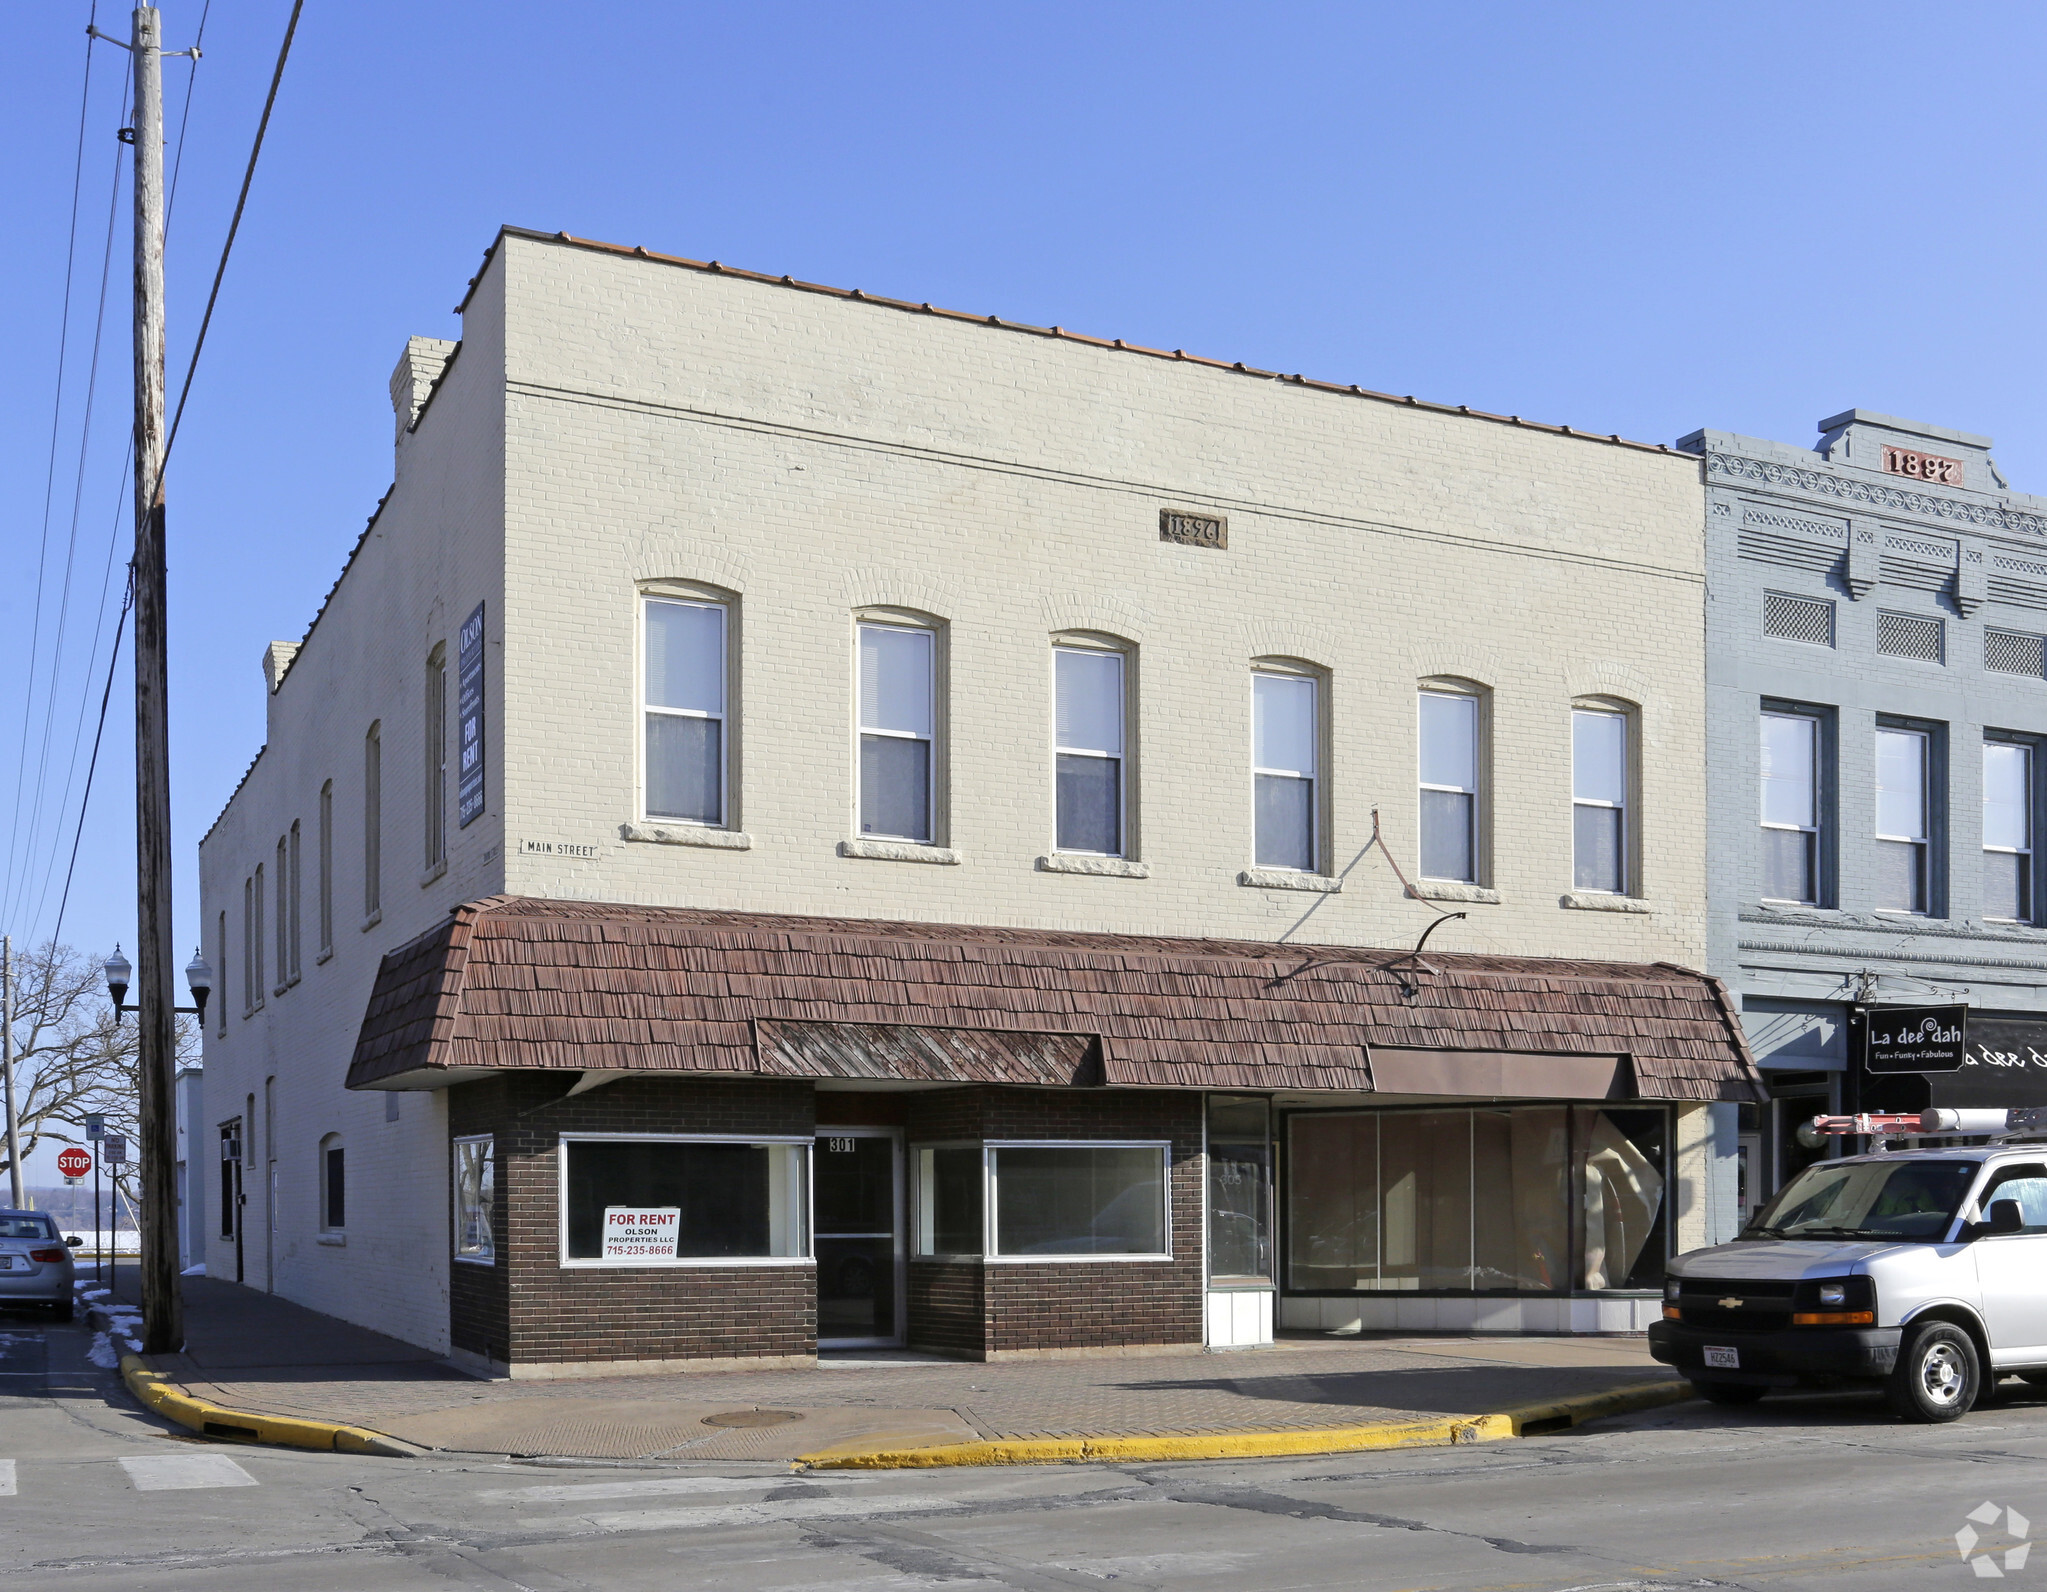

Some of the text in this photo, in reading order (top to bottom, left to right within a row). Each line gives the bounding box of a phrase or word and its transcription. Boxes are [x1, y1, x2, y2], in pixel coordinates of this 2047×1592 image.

[460, 611, 482, 654] OLSON
[464, 716, 477, 745] FOR
[462, 740, 479, 773] RENT
[527, 841, 594, 857] MAIN STREET
[1871, 1025, 1961, 1045] La dee dah
[1875, 1049, 1954, 1061] Fun Funky Fabulous
[1977, 1043, 2026, 1068] dee
[830, 1137, 854, 1151] 301
[59, 1156, 90, 1169] STOP
[608, 1214, 676, 1225] FOR RENT
[625, 1228, 658, 1236] OLSON
[606, 1245, 673, 1255] 715-235-8666
